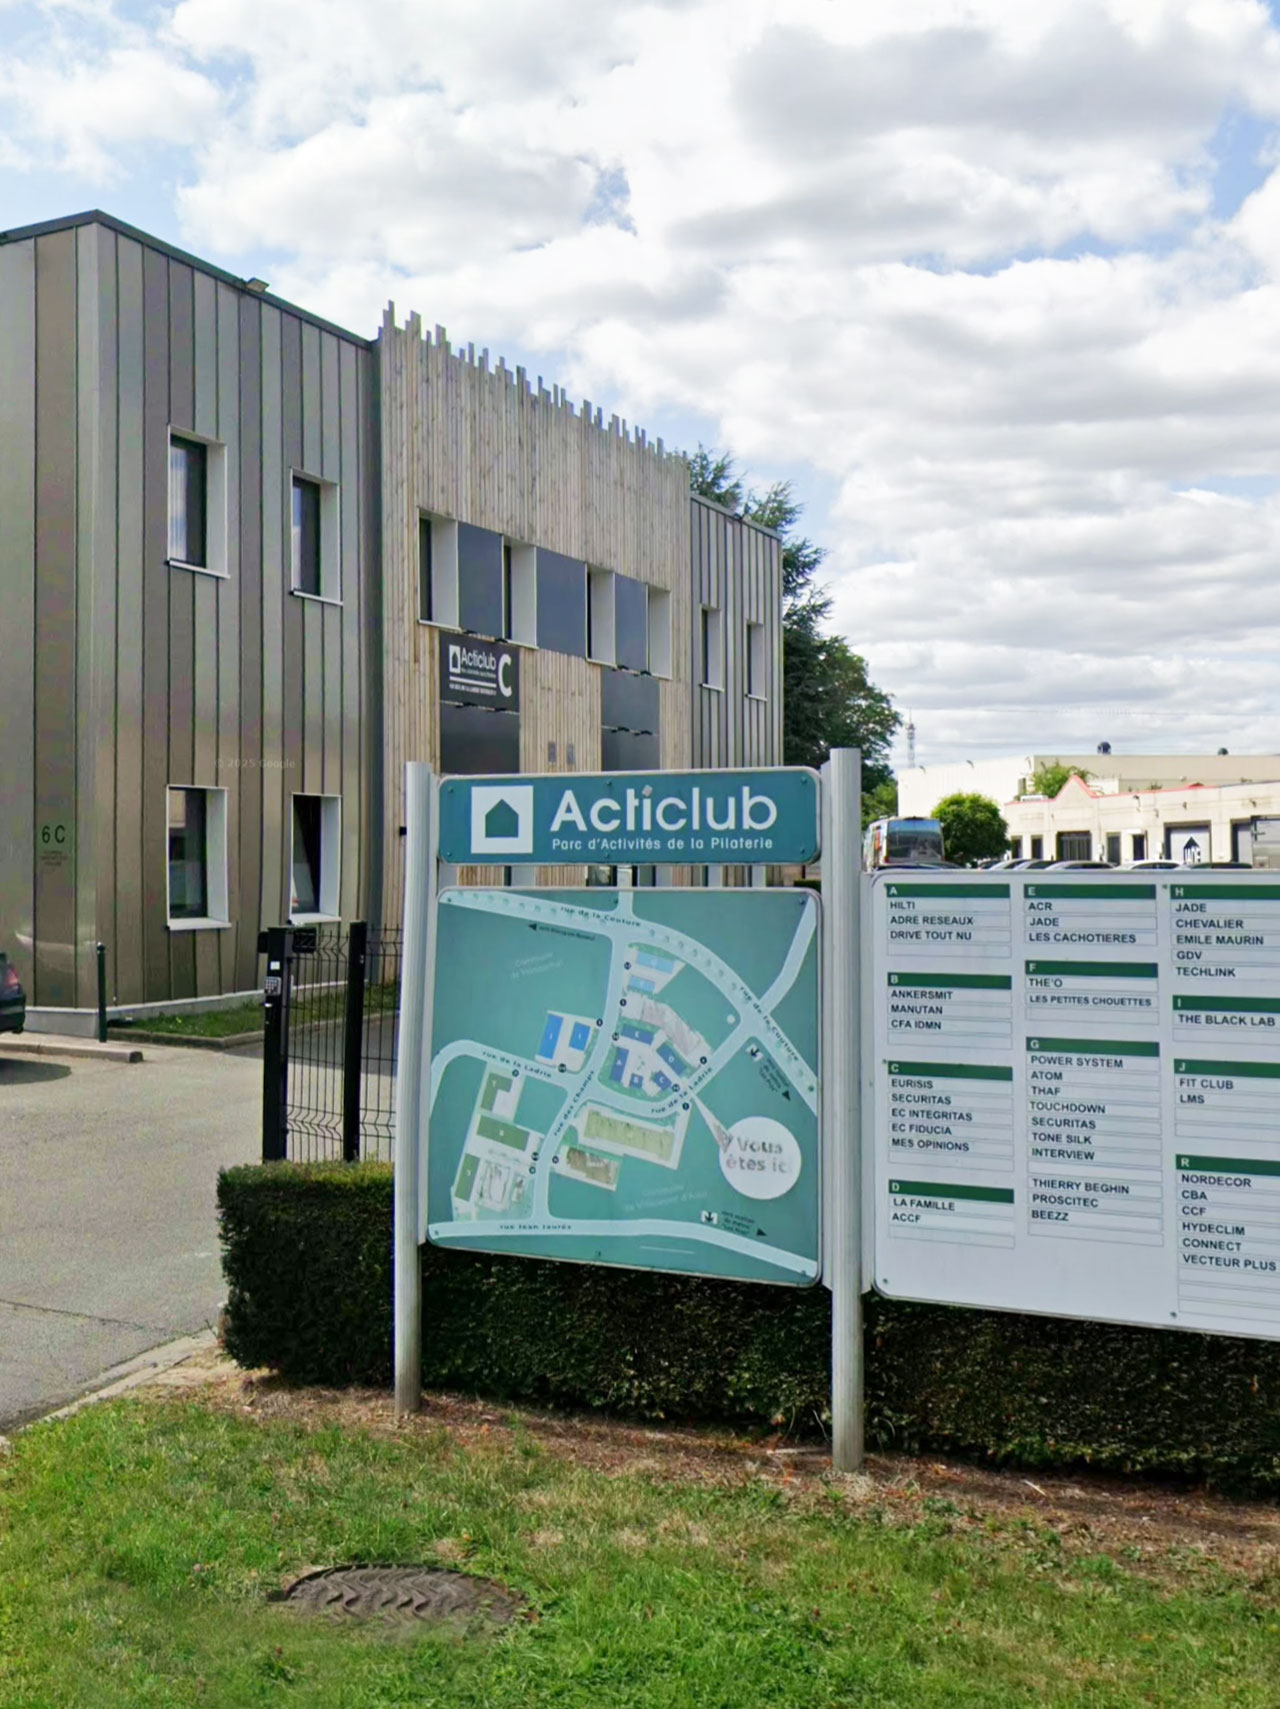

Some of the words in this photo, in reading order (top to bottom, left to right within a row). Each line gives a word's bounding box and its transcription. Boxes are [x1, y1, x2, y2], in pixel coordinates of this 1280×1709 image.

[461, 647, 496, 670] Acticlub
[498, 654, 512, 697] C
[549, 784, 777, 832] Acticlub
[552, 838, 581, 851] Parc
[588, 837, 661, 851] d'Activités
[667, 837, 685, 850] de
[691, 837, 704, 850] la
[711, 836, 773, 850] Pilaterie
[889, 887, 898, 896] A
[1028, 887, 1035, 896] E
[1175, 888, 1184, 897] H
[890, 901, 915, 910] HILTI
[1028, 902, 1052, 911] ACR
[1175, 904, 1207, 913] JADE
[890, 916, 919, 925] ADRE
[922, 916, 974, 926] RESEAUX
[1029, 917, 1059, 927] JADE
[1176, 919, 1244, 929] CHEVALIER
[890, 931, 921, 940] DRIVE
[925, 931, 953, 940] TOUT
[956, 931, 972, 941] NU
[1029, 933, 1050, 942] LES
[1054, 933, 1136, 944] CACHOTIERES
[1176, 935, 1214, 945] EMILE
[1216, 935, 1264, 945] MAURIN
[1177, 951, 1203, 960] GDV
[1029, 963, 1036, 972] F
[1176, 966, 1236, 977] TECHLINK
[890, 975, 898, 984] B
[1029, 978, 1063, 988] THE'O
[891, 990, 953, 1000] ANKERSMIT
[1029, 995, 1048, 1004] LES
[1051, 995, 1089, 1005] PETITES
[1092, 997, 1152, 1007] CHOUETTES
[891, 1005, 943, 1015] MANUTAN
[891, 1020, 912, 1029] CFA
[914, 1020, 941, 1030] IDMN
[1178, 1014, 1202, 1024] THE
[1205, 1015, 1247, 1026] BLACK
[1251, 1016, 1276, 1027] LAB
[1030, 1040, 1039, 1049] G
[1031, 1055, 1073, 1066] POWER
[1076, 1057, 1124, 1068] SYSTEM
[891, 1064, 899, 1073] C
[1179, 1062, 1186, 1072] J
[1031, 1071, 1063, 1081] ATOM
[891, 1079, 933, 1089] EURISIS
[1179, 1078, 1197, 1088] FIT
[1200, 1079, 1234, 1090] CLUB
[1031, 1086, 1061, 1096] THAF
[891, 1093, 951, 1105] SECURITAS
[1180, 1094, 1205, 1104] LMS
[1030, 1101, 1106, 1114] TOUCHDOWN
[892, 1108, 906, 1117] EC
[909, 1110, 973, 1122] INTEGRITAS
[1032, 1117, 1096, 1130] SECURITAS
[892, 1123, 906, 1132] EC
[909, 1124, 952, 1135] FIDUCIA
[1032, 1132, 1062, 1142] TONE
[1066, 1134, 1092, 1145] SILK
[738, 1138, 783, 1154] Vous
[892, 1138, 914, 1148] MES
[917, 1140, 969, 1151] OPINIONS
[1032, 1148, 1095, 1160] INTERVIEW
[1181, 1158, 1190, 1168] R
[1181, 1174, 1251, 1188] NORDECOR
[892, 1183, 900, 1191] D
[1032, 1179, 1081, 1191] THIERRY
[1084, 1182, 1130, 1194] BEGHIN
[1182, 1190, 1208, 1200] CBA
[893, 1198, 907, 1207] LA
[910, 1199, 955, 1211] FAMILLE
[1032, 1194, 1098, 1208] PROSCITEC
[1032, 1210, 1069, 1222] BEEZZ
[1182, 1206, 1206, 1216] CCF
[892, 1213, 921, 1223] ACCF
[1182, 1222, 1246, 1236] HYDECLIM
[1183, 1238, 1242, 1252] CONNECT
[1183, 1254, 1240, 1268] VECTEUR
[1244, 1259, 1276, 1271] PLUS
